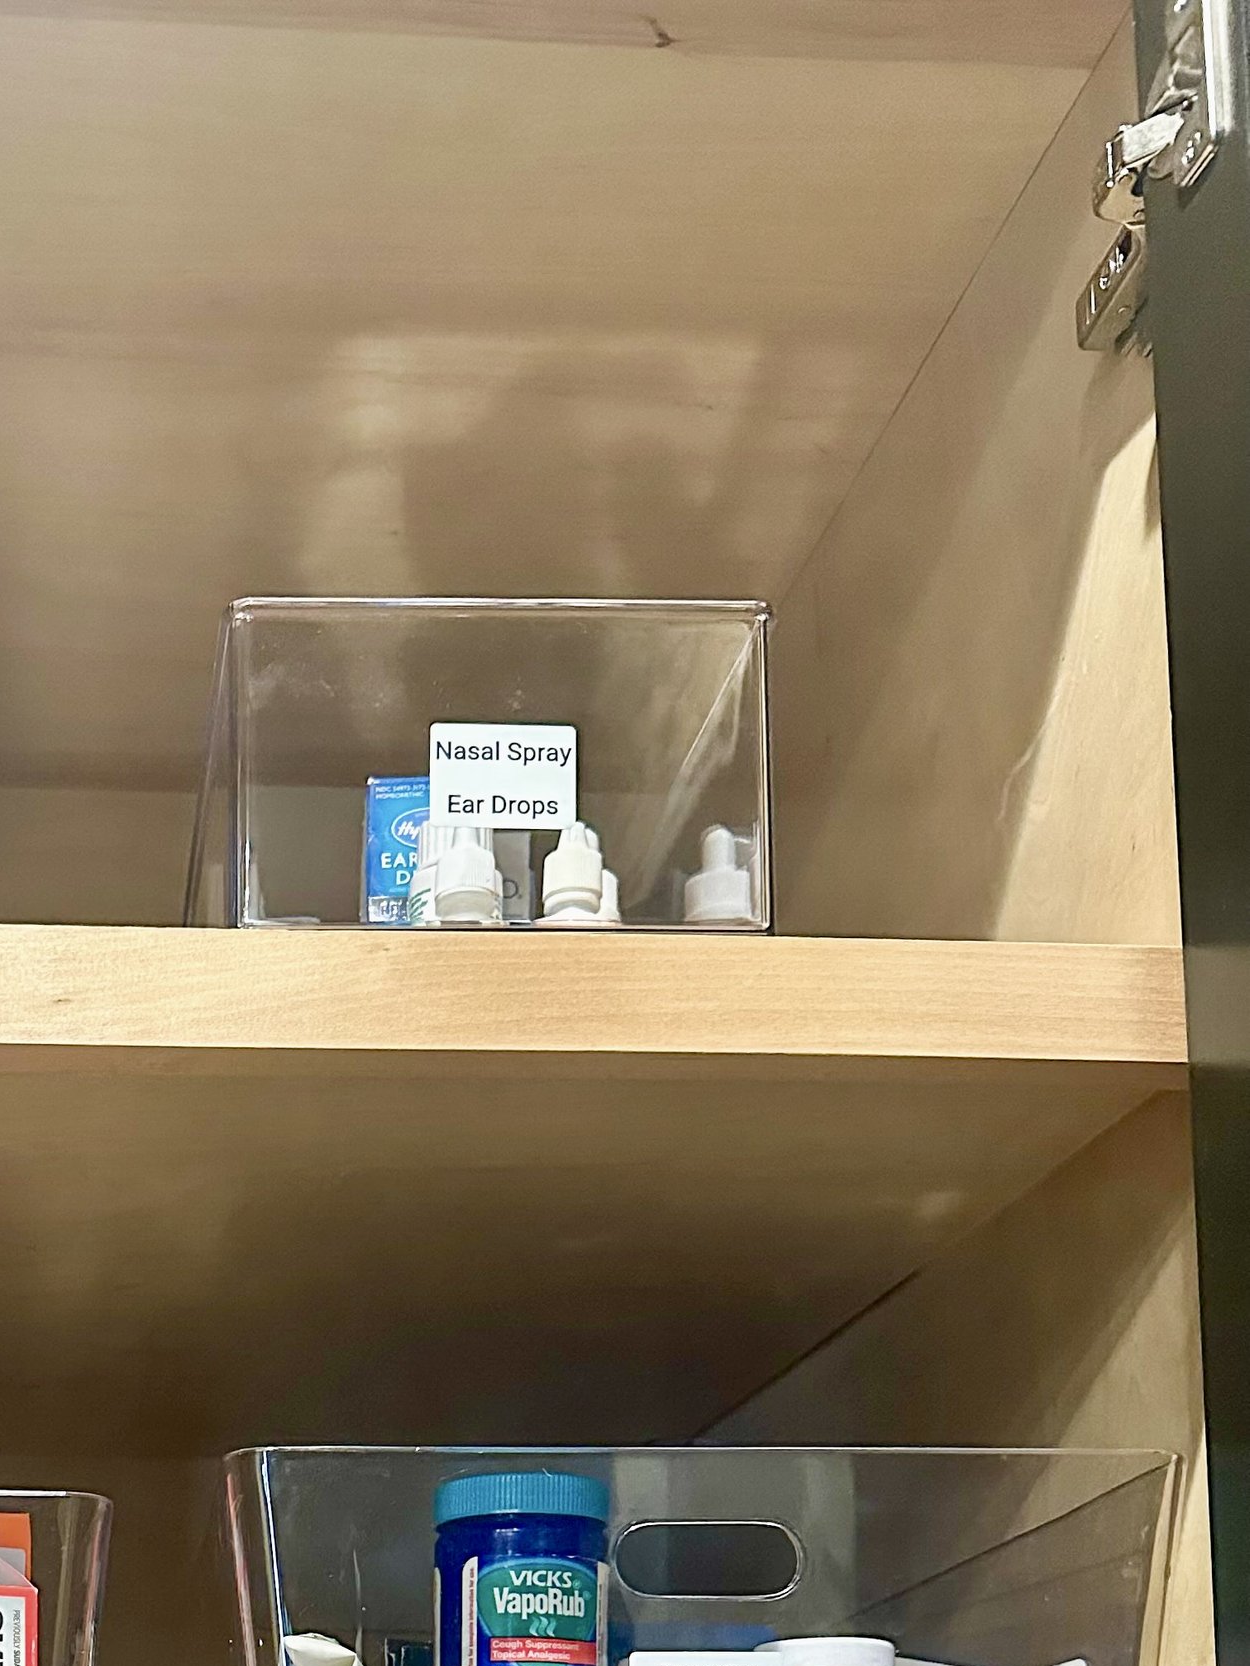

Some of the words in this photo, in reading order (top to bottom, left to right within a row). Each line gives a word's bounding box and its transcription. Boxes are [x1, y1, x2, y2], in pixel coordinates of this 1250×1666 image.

[435, 740, 501, 761] Nasal
[506, 741, 573, 767] Spray
[448, 794, 485, 814] Ear
[491, 794, 559, 820] Drops
[509, 1570, 573, 1588] VICKS
[493, 1587, 586, 1620] VapoRub
[492, 1639, 523, 1650] Cough
